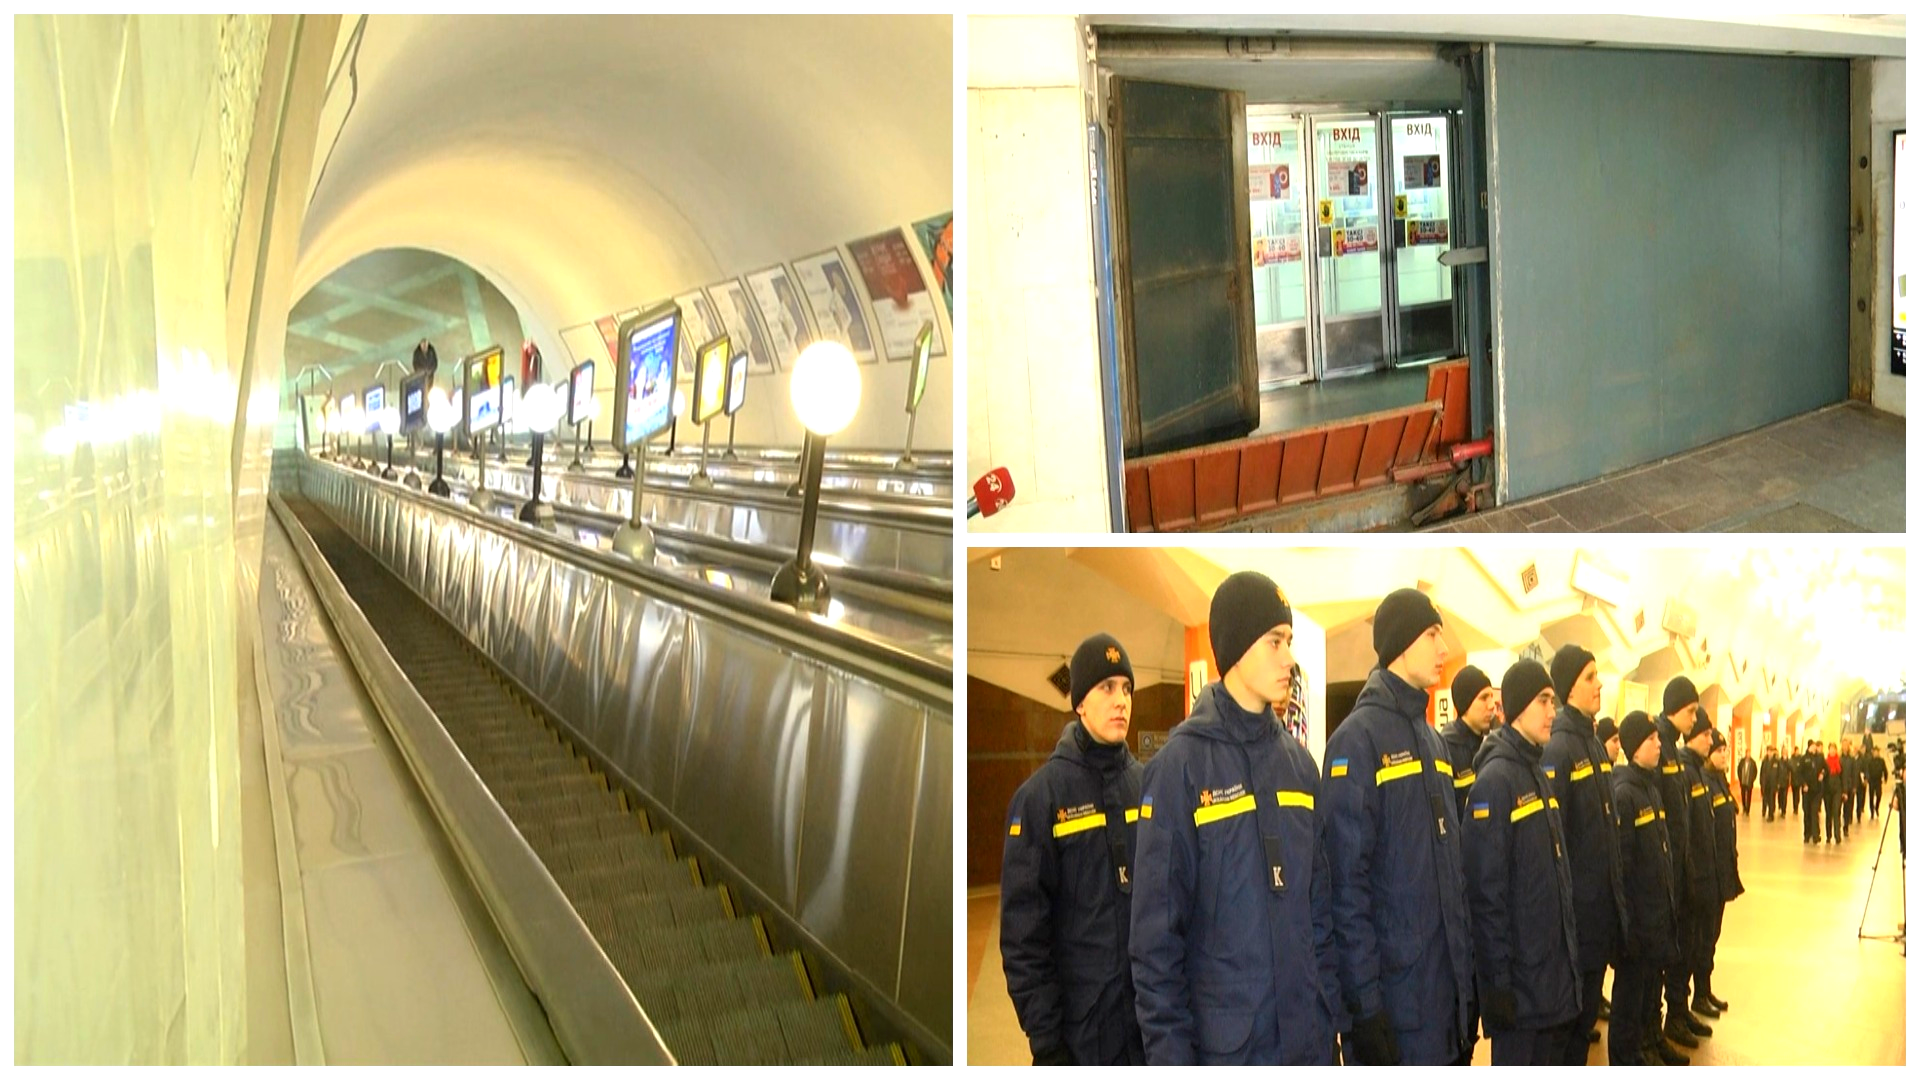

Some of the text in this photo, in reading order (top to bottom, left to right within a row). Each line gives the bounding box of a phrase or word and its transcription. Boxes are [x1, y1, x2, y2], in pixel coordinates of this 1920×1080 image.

[1332, 127, 1360, 142] ВХІД
[1406, 123, 1433, 137] ВХІД
[1252, 131, 1281, 147] ВХІД
[1438, 817, 1447, 835] К
[1118, 866, 1129, 883] К
[1272, 866, 1284, 887] К
